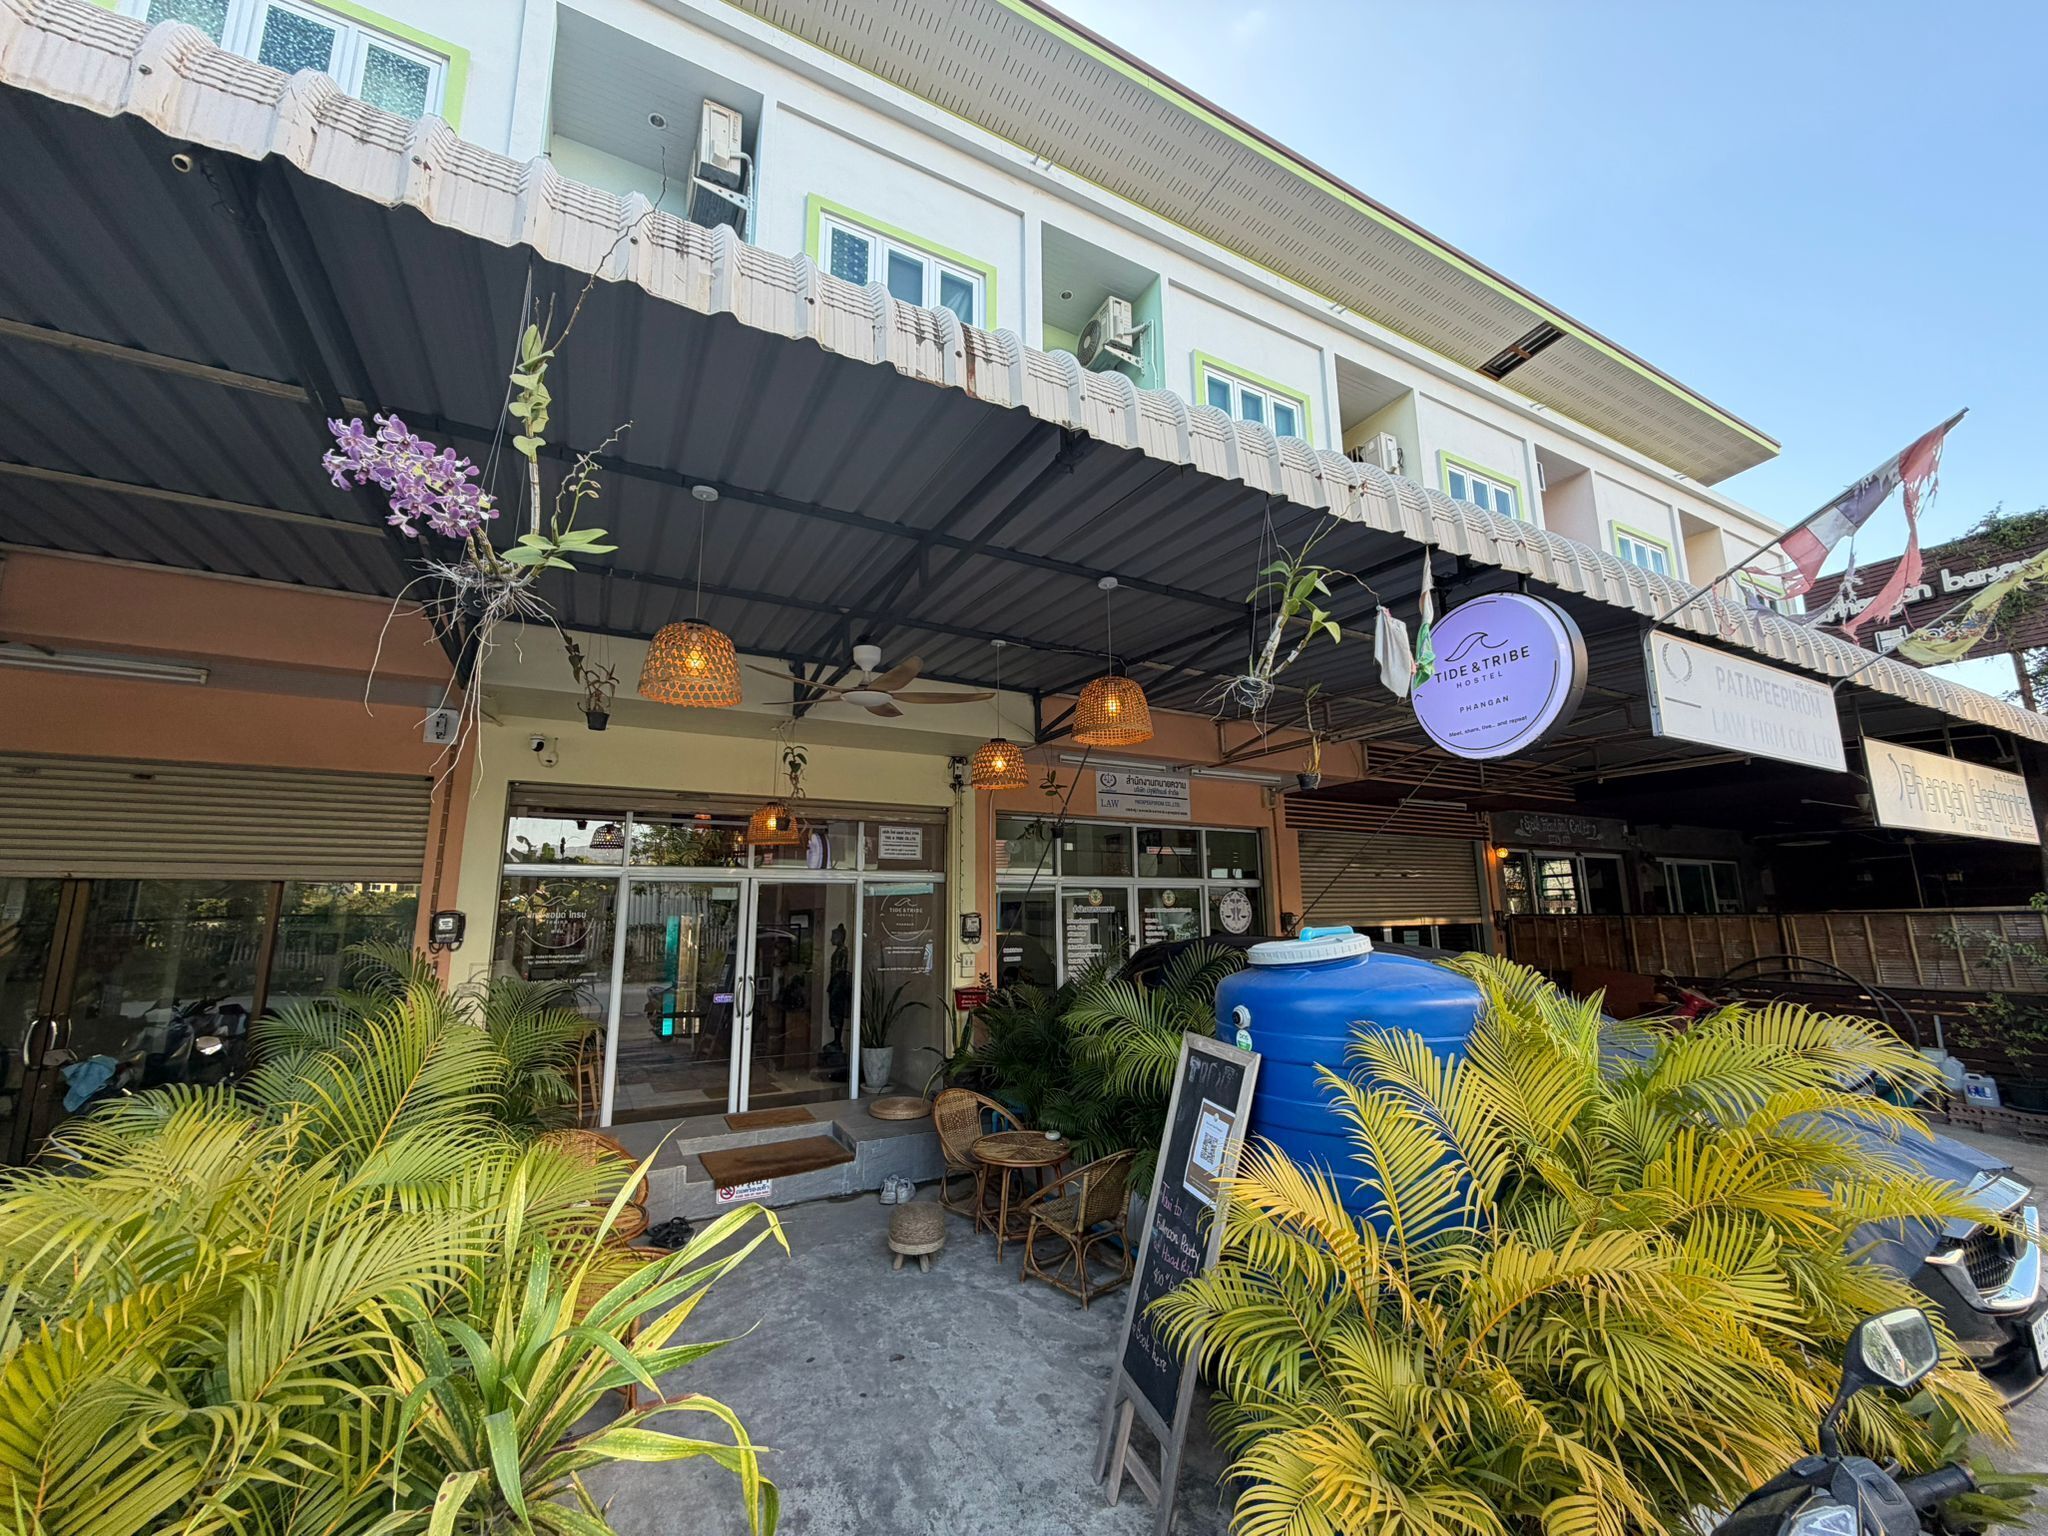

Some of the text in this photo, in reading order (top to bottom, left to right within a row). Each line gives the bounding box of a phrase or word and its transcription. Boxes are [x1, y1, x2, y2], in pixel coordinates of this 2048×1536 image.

[1434, 665, 1468, 683] TIDE
[1482, 645, 1530, 670] TRIBE
[1456, 671, 1503, 688] HOSTEL
[1459, 695, 1509, 713] PHANGAN
[1101, 799, 1119, 808] LAW
